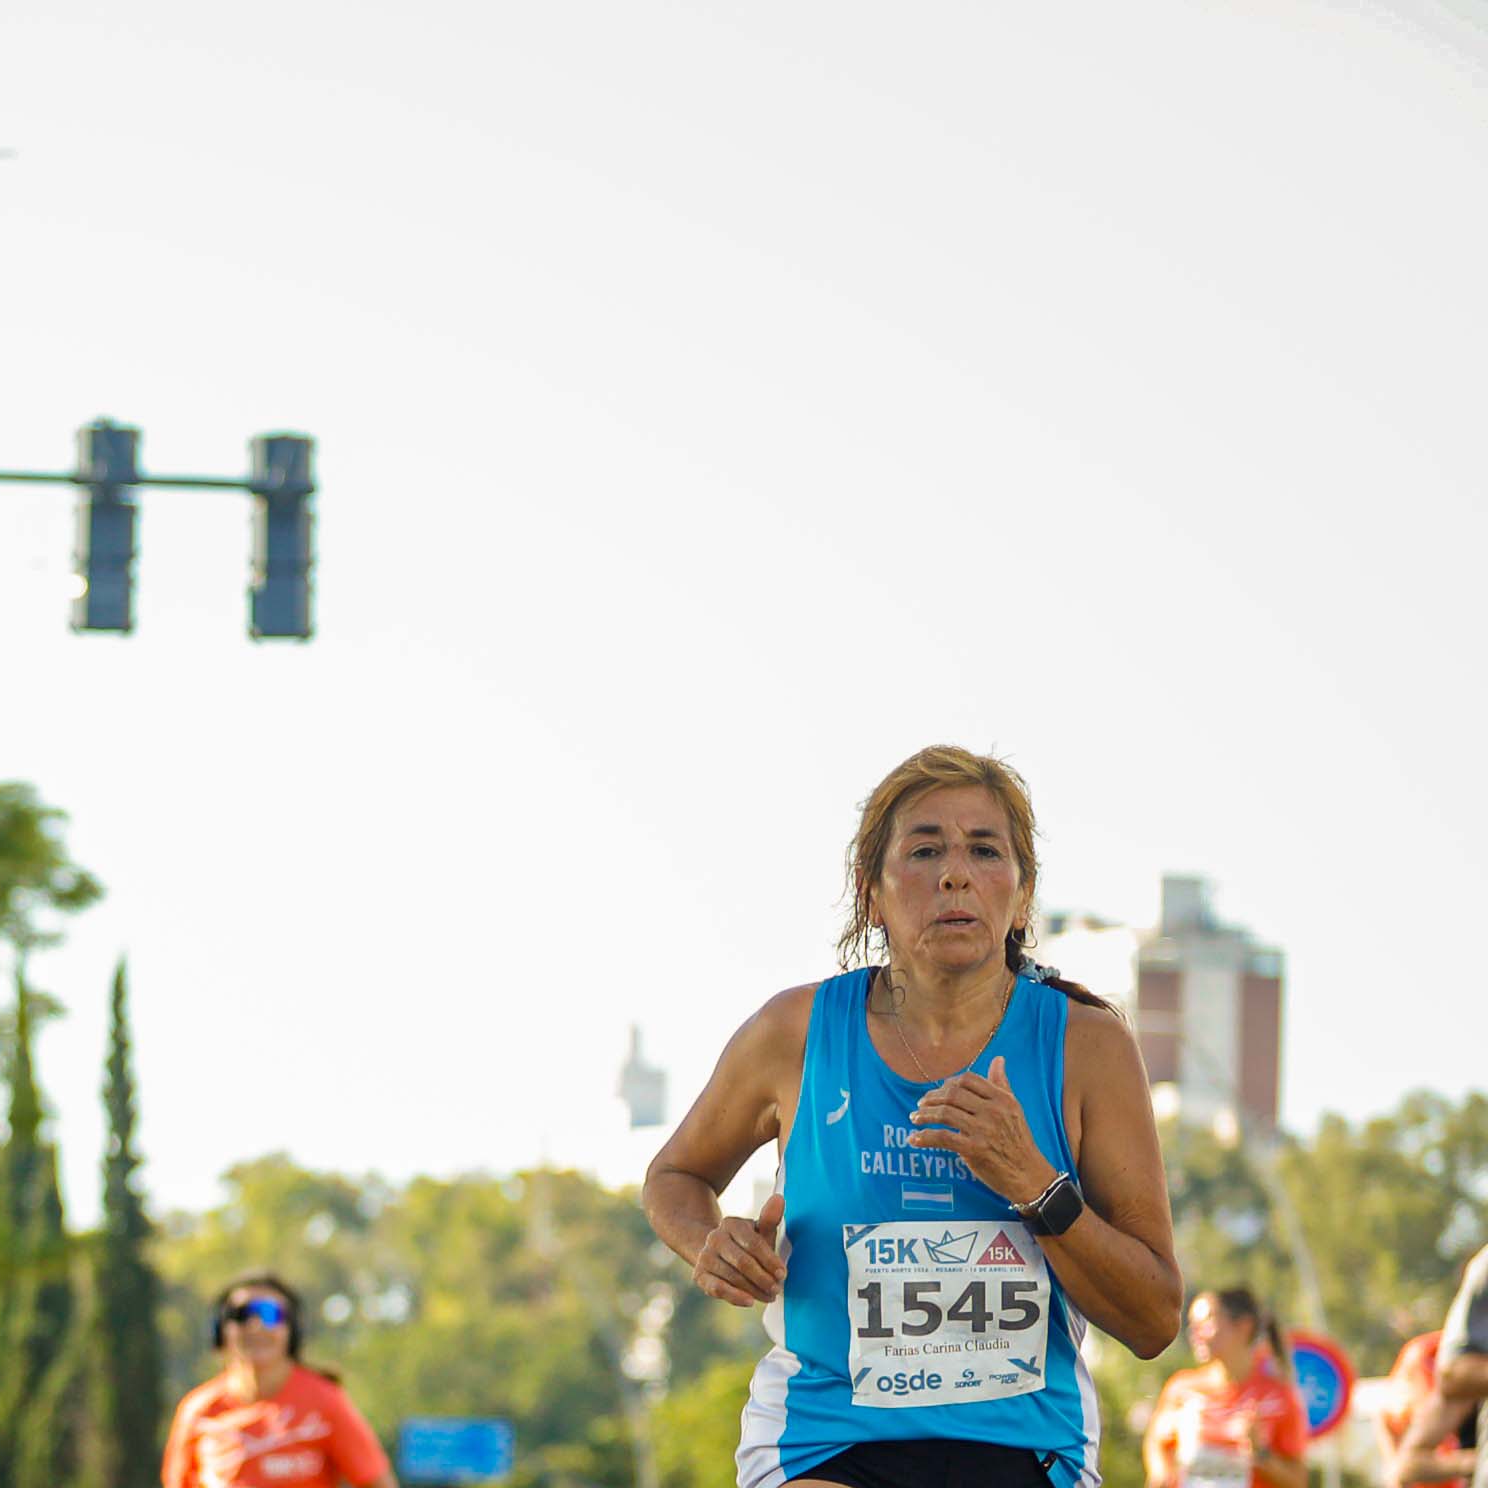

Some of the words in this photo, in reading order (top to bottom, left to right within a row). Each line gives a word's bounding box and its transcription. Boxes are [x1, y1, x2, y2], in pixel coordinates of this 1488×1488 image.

[864, 1238, 919, 1265] 15K
[988, 1246, 1016, 1260] 15K
[857, 1281, 1041, 1338] 1545
[885, 1344, 920, 1357] Farias
[923, 1342, 961, 1354] Carina
[965, 1338, 1010, 1352] Claudia
[876, 1369, 943, 1395] osde
